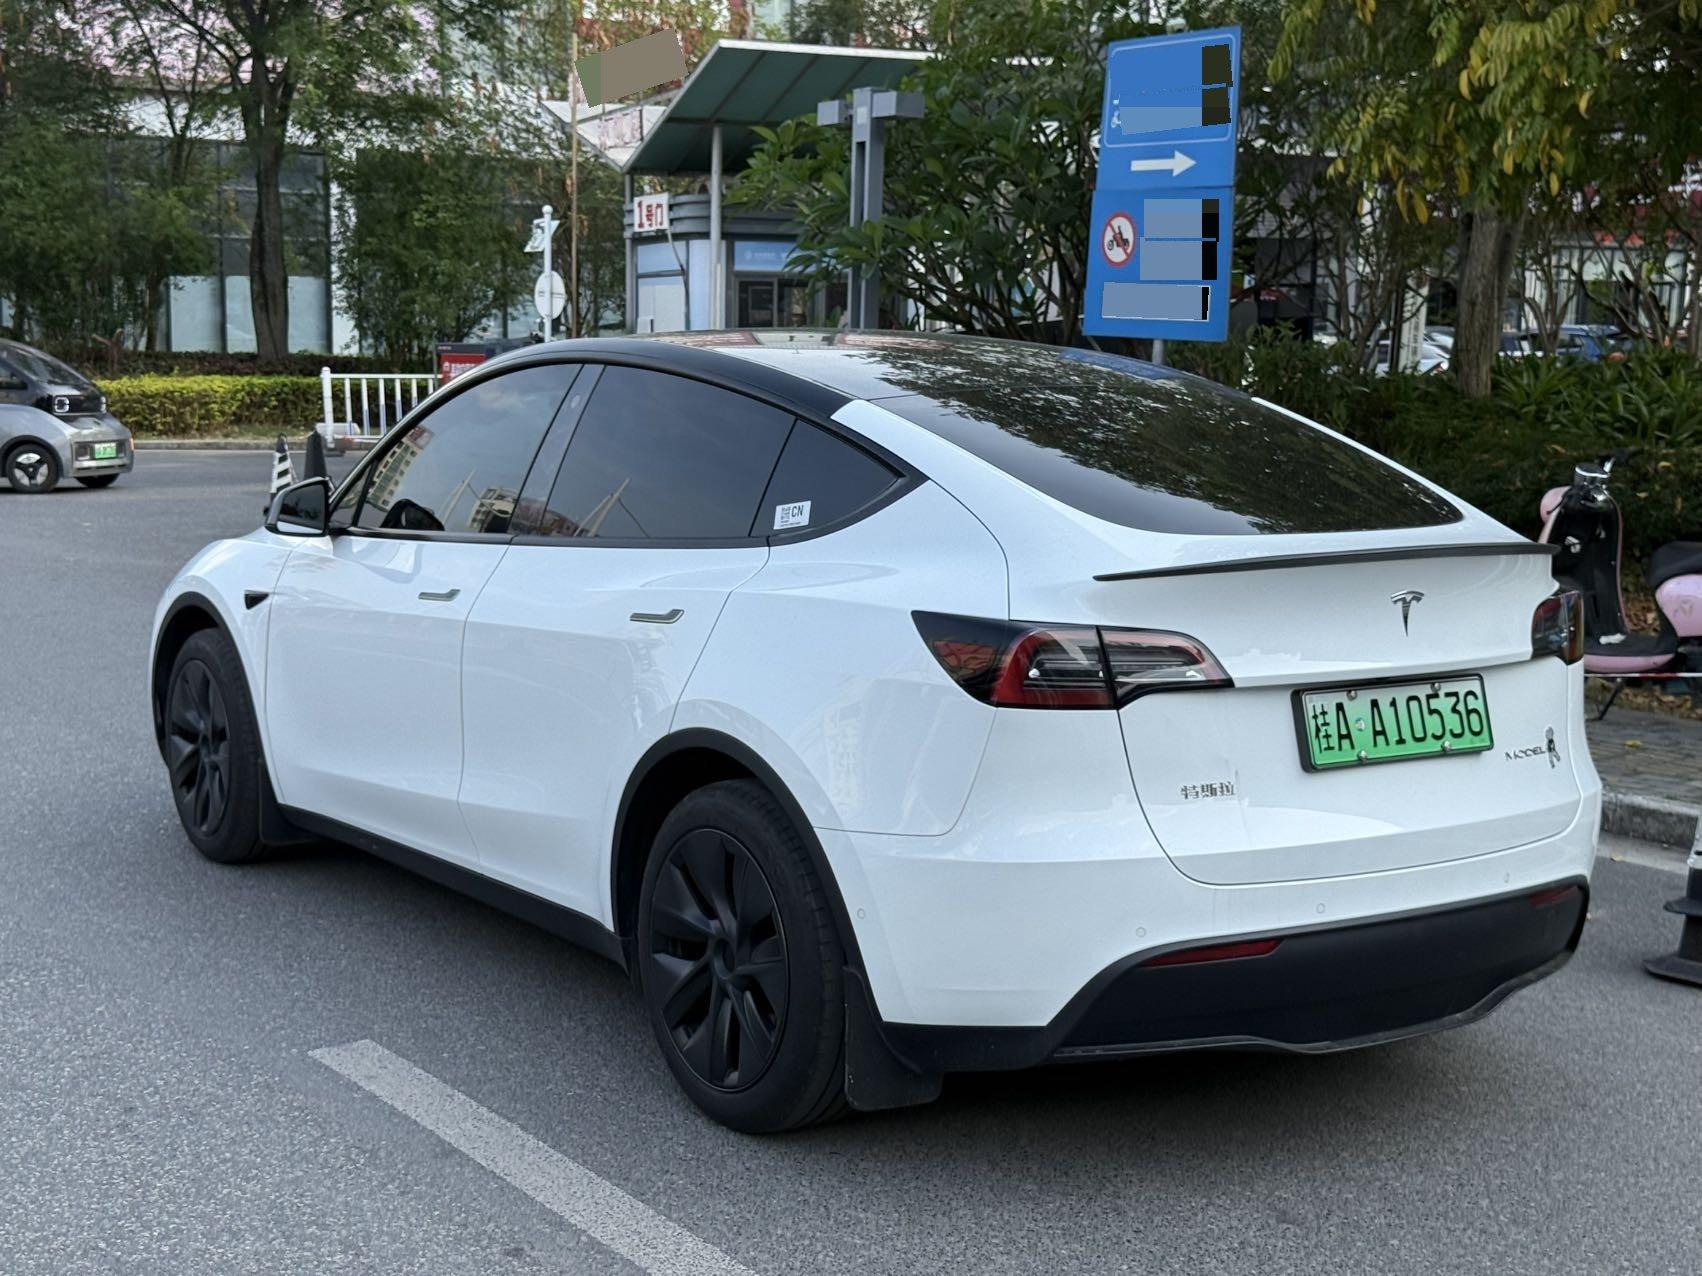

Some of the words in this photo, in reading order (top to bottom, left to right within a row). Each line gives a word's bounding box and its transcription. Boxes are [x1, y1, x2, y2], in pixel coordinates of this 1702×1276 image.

[637, 200, 664, 229] 1号门
[791, 505, 804, 518] CN
[1370, 690, 1484, 747] A10536
[1504, 746, 1546, 761] MODEL
[1181, 780, 1235, 800] 特斯拉
